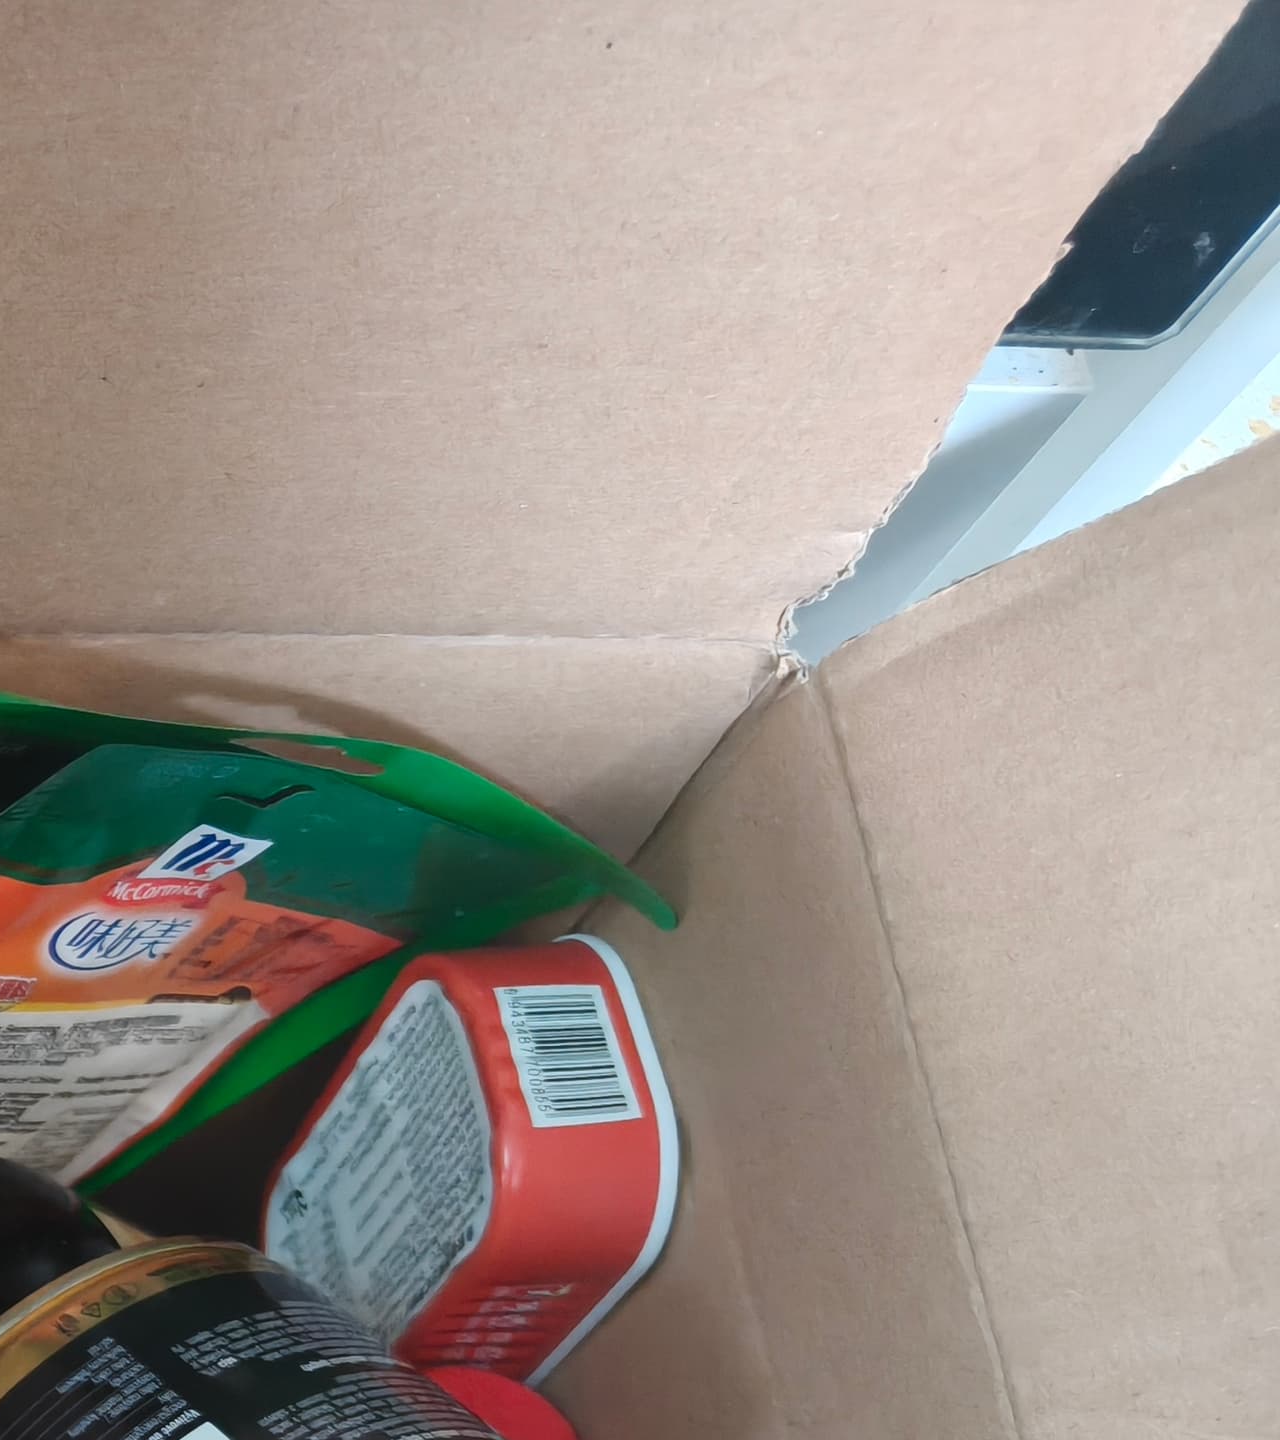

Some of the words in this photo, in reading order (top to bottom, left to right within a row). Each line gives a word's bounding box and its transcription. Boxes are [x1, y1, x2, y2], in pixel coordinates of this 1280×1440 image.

[107, 881, 212, 901] McCormick
[68, 914, 193, 960] 味好美
